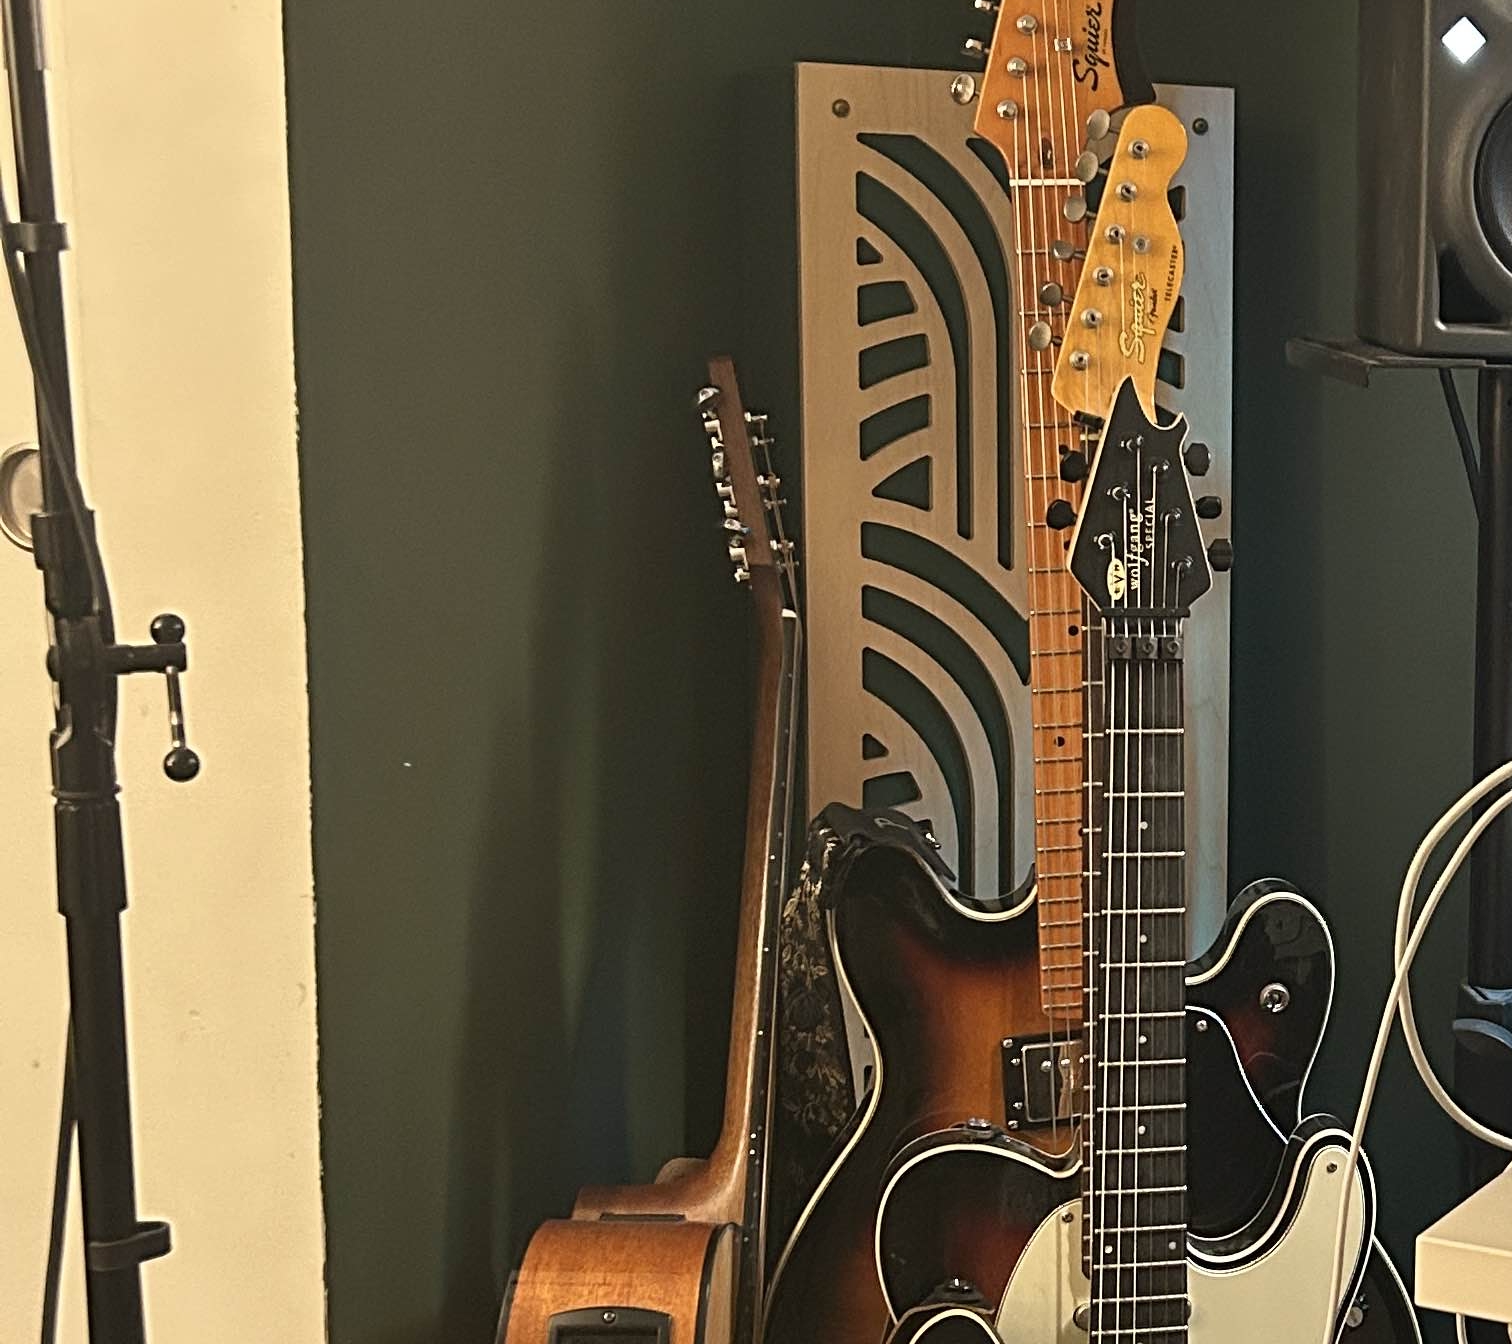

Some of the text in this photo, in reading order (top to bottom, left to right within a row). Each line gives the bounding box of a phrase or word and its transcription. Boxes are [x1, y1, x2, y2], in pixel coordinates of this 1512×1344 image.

[1073, 1, 1110, 92] Squier
[1163, 245, 1180, 303] TELECASTER
[1119, 272, 1157, 364] Squier
[1125, 511, 1150, 591] wolfgang
[1143, 496, 1156, 550] SPECIAL
